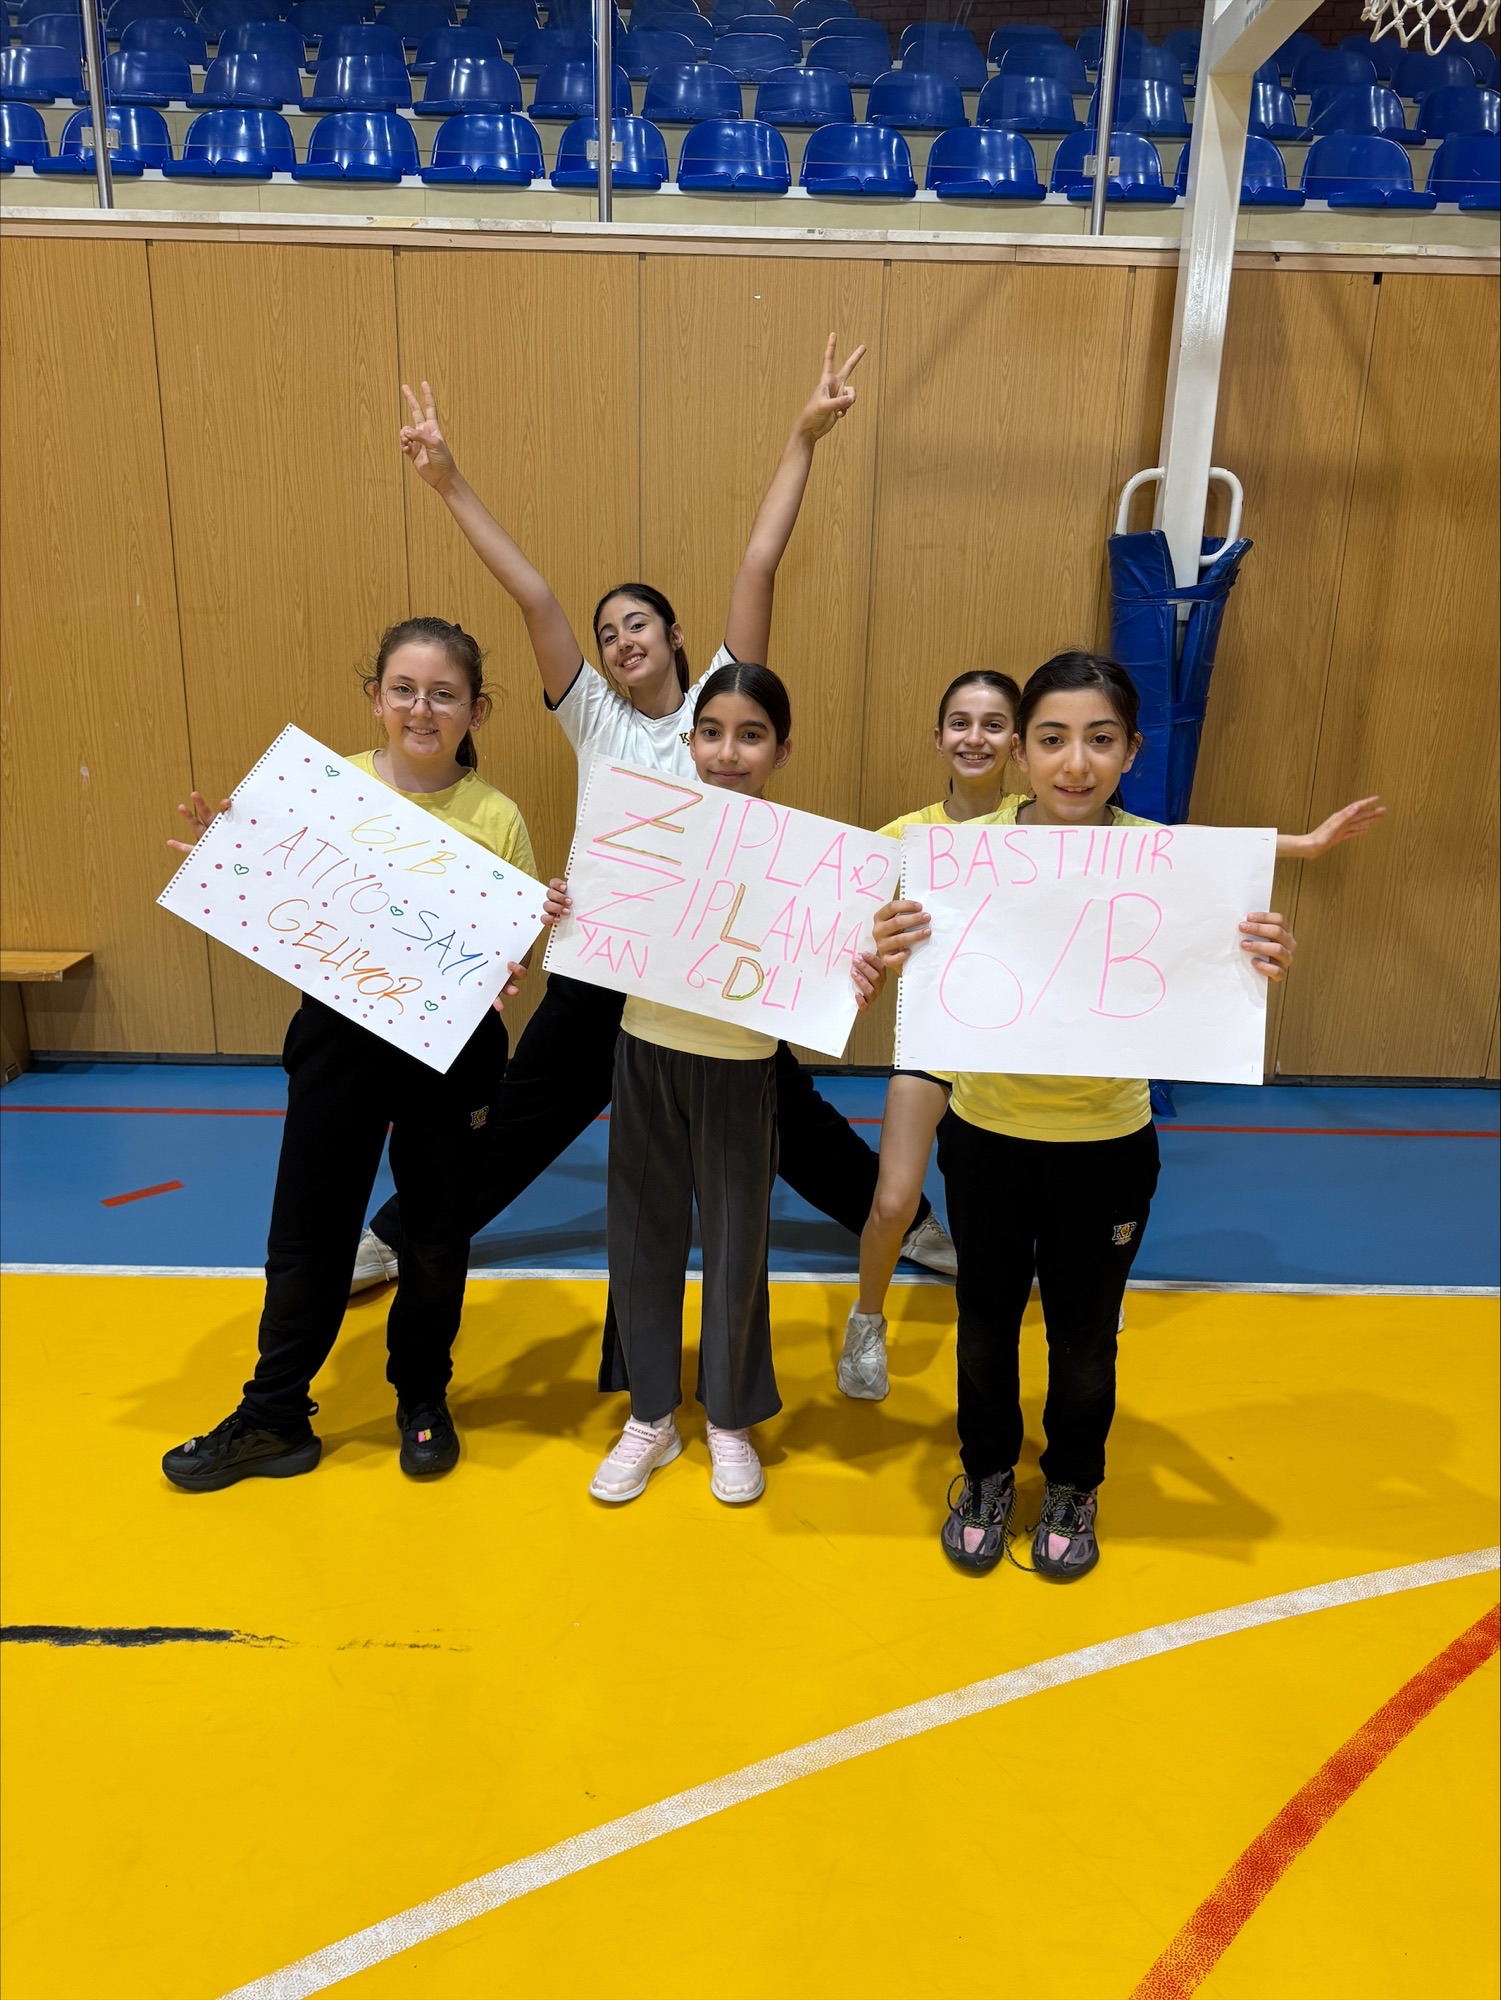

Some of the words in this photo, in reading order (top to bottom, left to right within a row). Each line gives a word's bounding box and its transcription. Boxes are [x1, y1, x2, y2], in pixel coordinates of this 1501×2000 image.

[349, 814, 457, 874] 6/B
[593, 767, 847, 900] ZIPLA
[263, 827, 390, 914] ATIYO
[392, 911, 488, 986] SAYI
[576, 850, 863, 977] ZIPLAMA
[577, 924, 649, 979] YAN
[939, 893, 1167, 1030] 6/B
